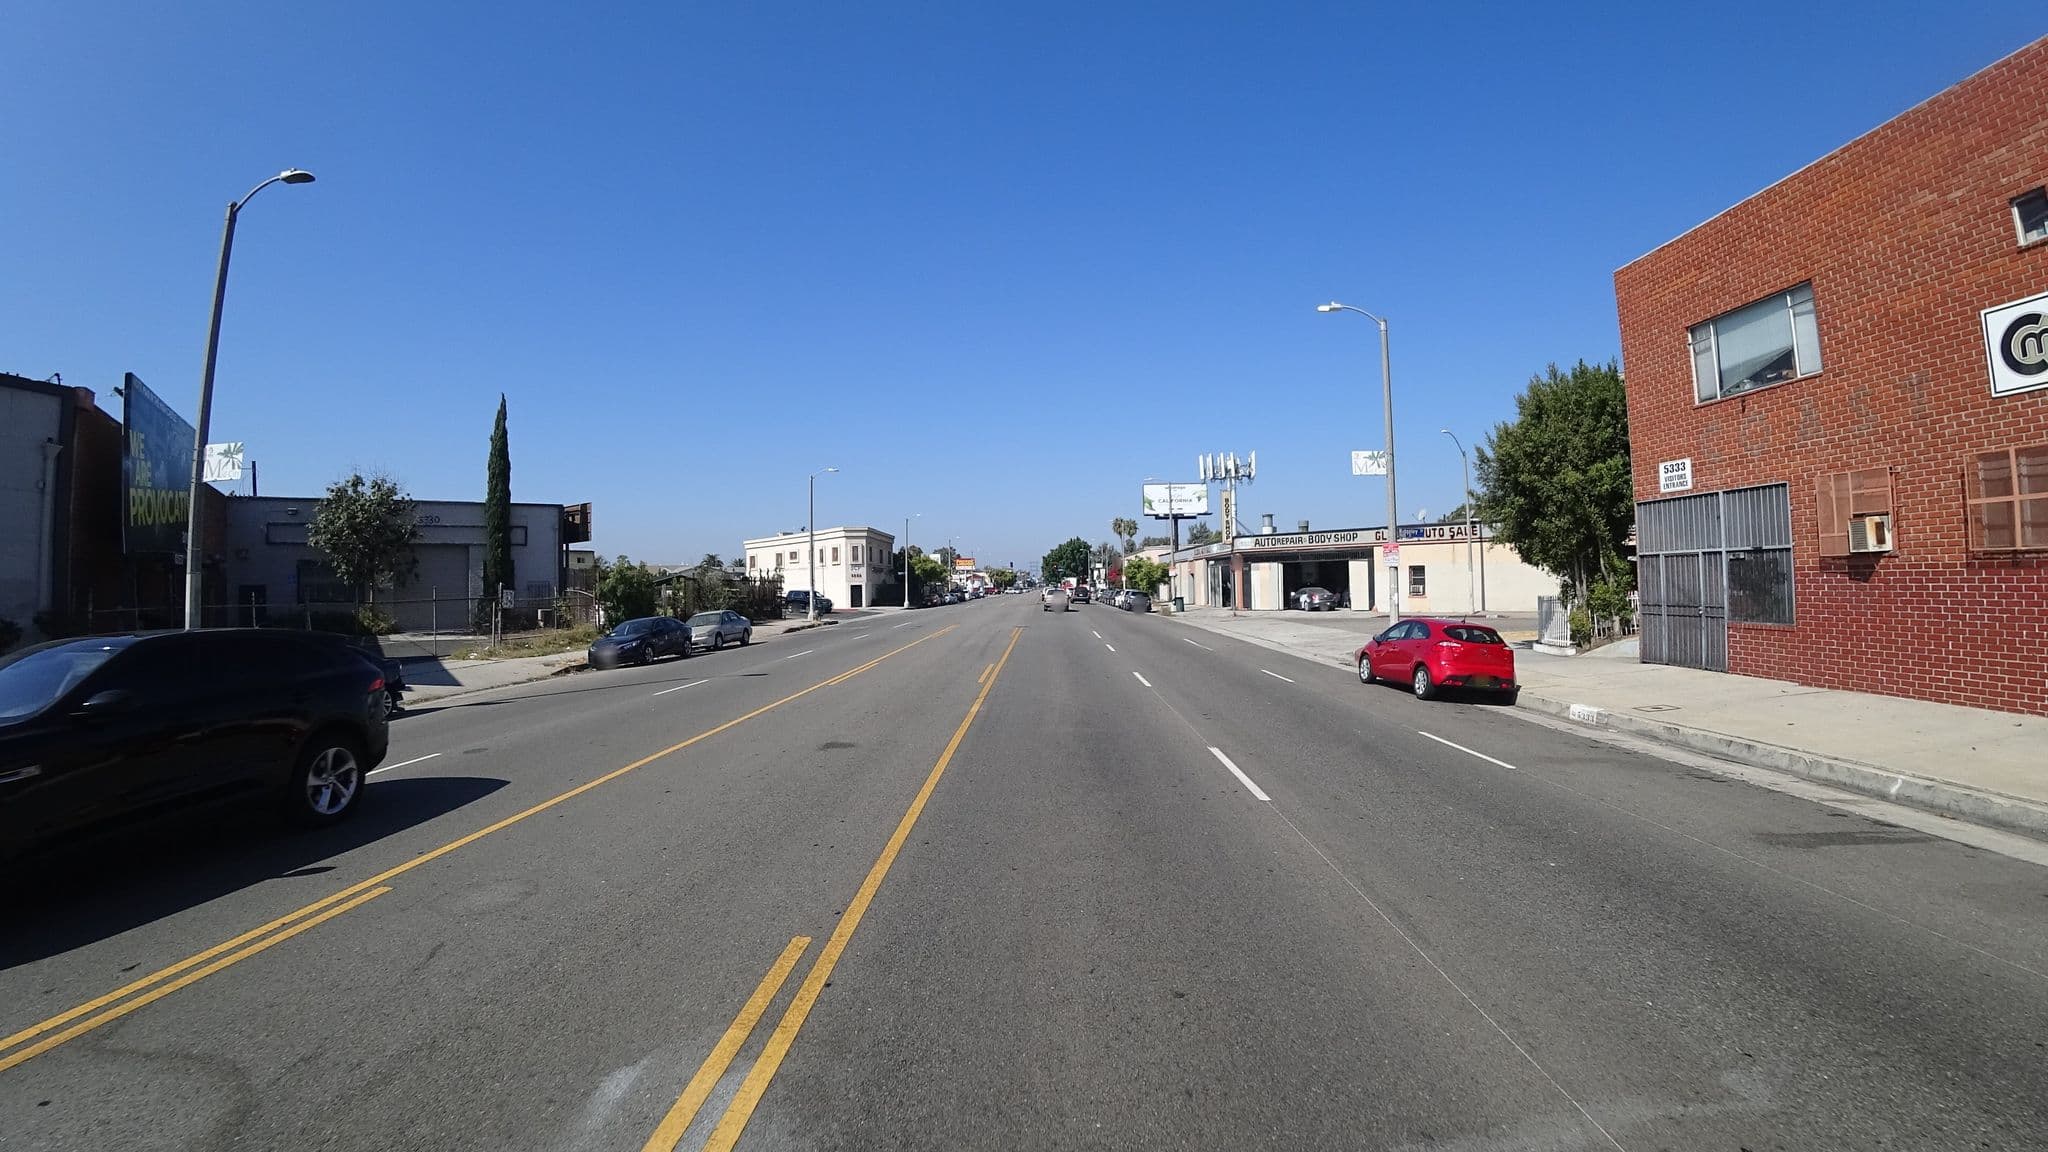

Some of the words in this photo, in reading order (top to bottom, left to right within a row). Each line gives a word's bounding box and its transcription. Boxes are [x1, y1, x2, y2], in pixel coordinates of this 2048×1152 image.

[129, 430, 145, 459] WE
[135, 461, 151, 487] ARE
[1663, 462, 1686, 474] 5333
[1664, 473, 1687, 482] VISITORS
[1663, 480, 1688, 490] ENTRANCE
[1308, 534, 1331, 544] BODY
[1334, 532, 1358, 542] SHOP
[1425, 528, 1444, 538] UTO
